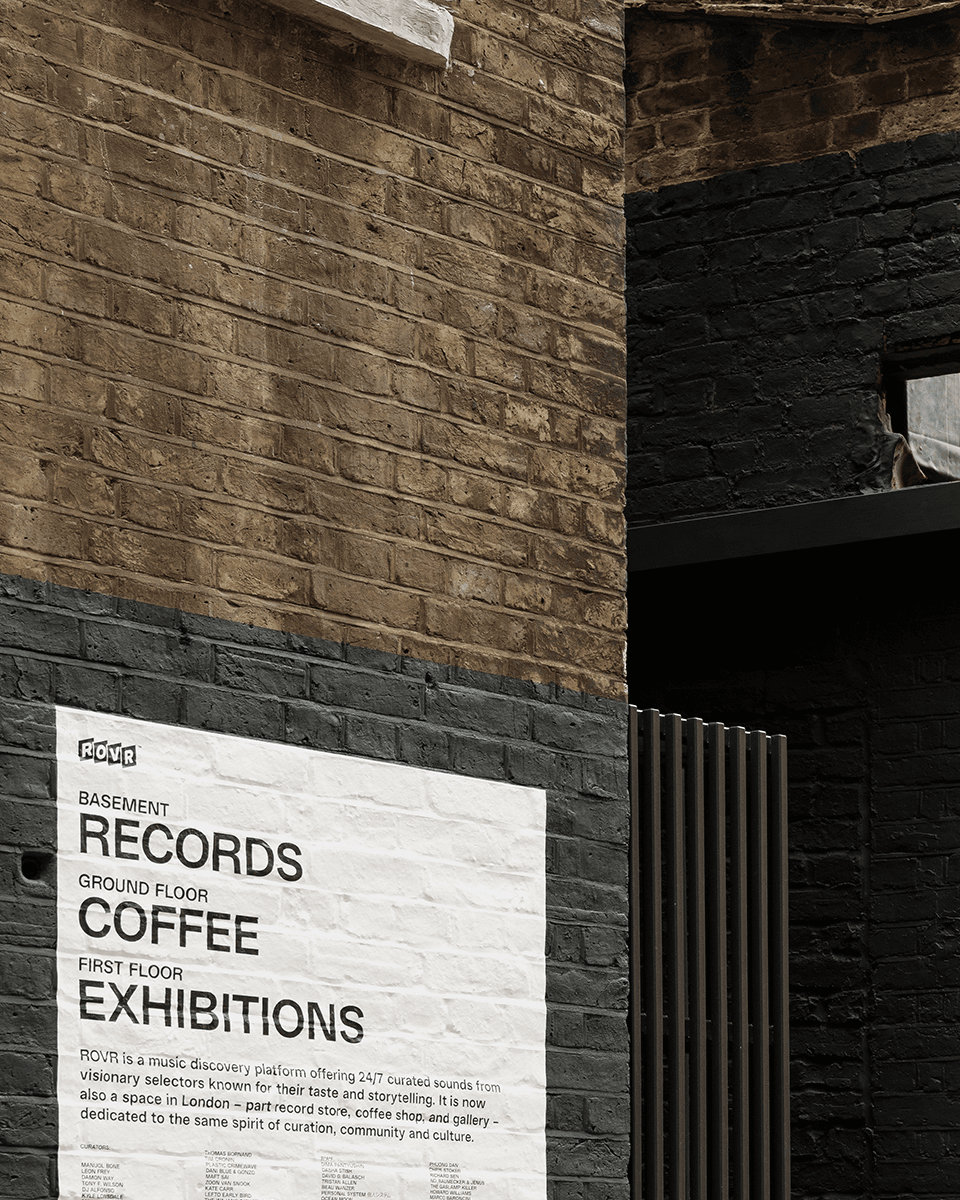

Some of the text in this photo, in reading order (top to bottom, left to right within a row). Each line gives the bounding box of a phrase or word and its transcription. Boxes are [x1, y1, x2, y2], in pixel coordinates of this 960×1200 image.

[78, 738, 136, 768] ROVR
[79, 791, 169, 817] BASEMENT
[79, 813, 303, 882] RECORDS
[78, 874, 209, 903] GROUND FLOOR
[78, 896, 259, 955] COFFEE
[78, 957, 184, 981] FIRST FLOOR
[78, 978, 364, 1044] EXHIBITIONS
[80, 1049, 501, 1093] ROVR is a music discovery platform offering 24/7 curated sounds from
[80, 1068, 486, 1109] visionary selectors known for their taste and storytelling. It is now
[80, 1088, 106, 1101] also
[110, 1092, 118, 1102] a
[122, 1093, 162, 1106] space
[166, 1094, 178, 1106] in
[182, 1095, 230, 1109] London
[246, 1100, 272, 1113] part
[274, 1103, 314, 1115] record
[318, 1104, 351, 1119] store,
[355, 1107, 392, 1120] coffee
[396, 1110, 425, 1124] shop,
[428, 1113, 450, 1124] and
[453, 1114, 490, 1129] gallery
[80, 1108, 474, 1142] dedicated to the same spirit of curation, community and culture.
